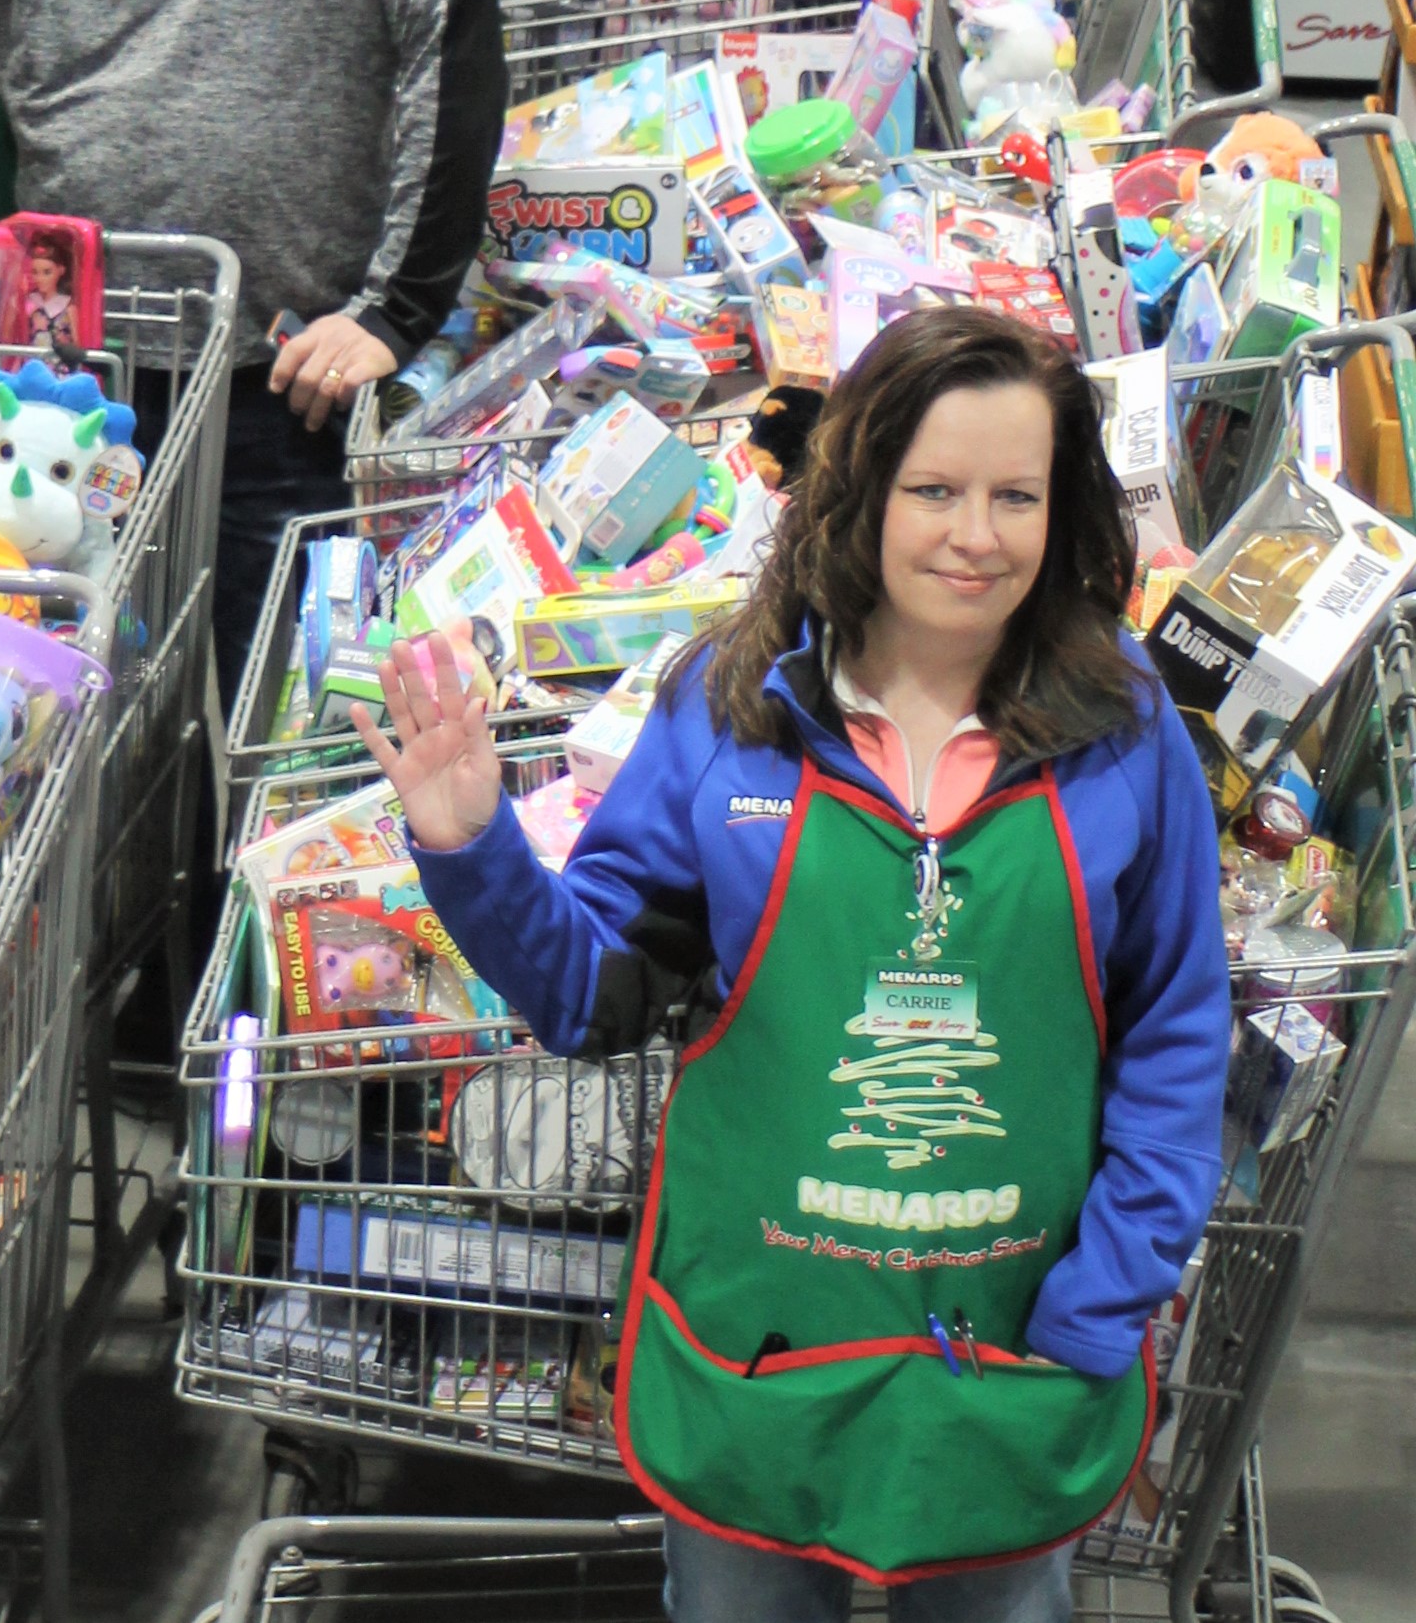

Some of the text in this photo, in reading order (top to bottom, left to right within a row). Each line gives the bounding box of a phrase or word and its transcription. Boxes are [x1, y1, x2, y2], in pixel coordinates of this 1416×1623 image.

[1285, 13, 1392, 52] Save
[1159, 610, 1227, 671] DUMP
[728, 796, 793, 816] MENA
[283, 911, 312, 1018] EASY TO USE
[877, 970, 964, 986] MENARDS
[885, 994, 953, 1010] CARRIE
[797, 1175, 1021, 1232] MENARDS
[759, 1217, 810, 1250] Your
[812, 1232, 883, 1269] Merry
[885, 1246, 988, 1271] Christmas
